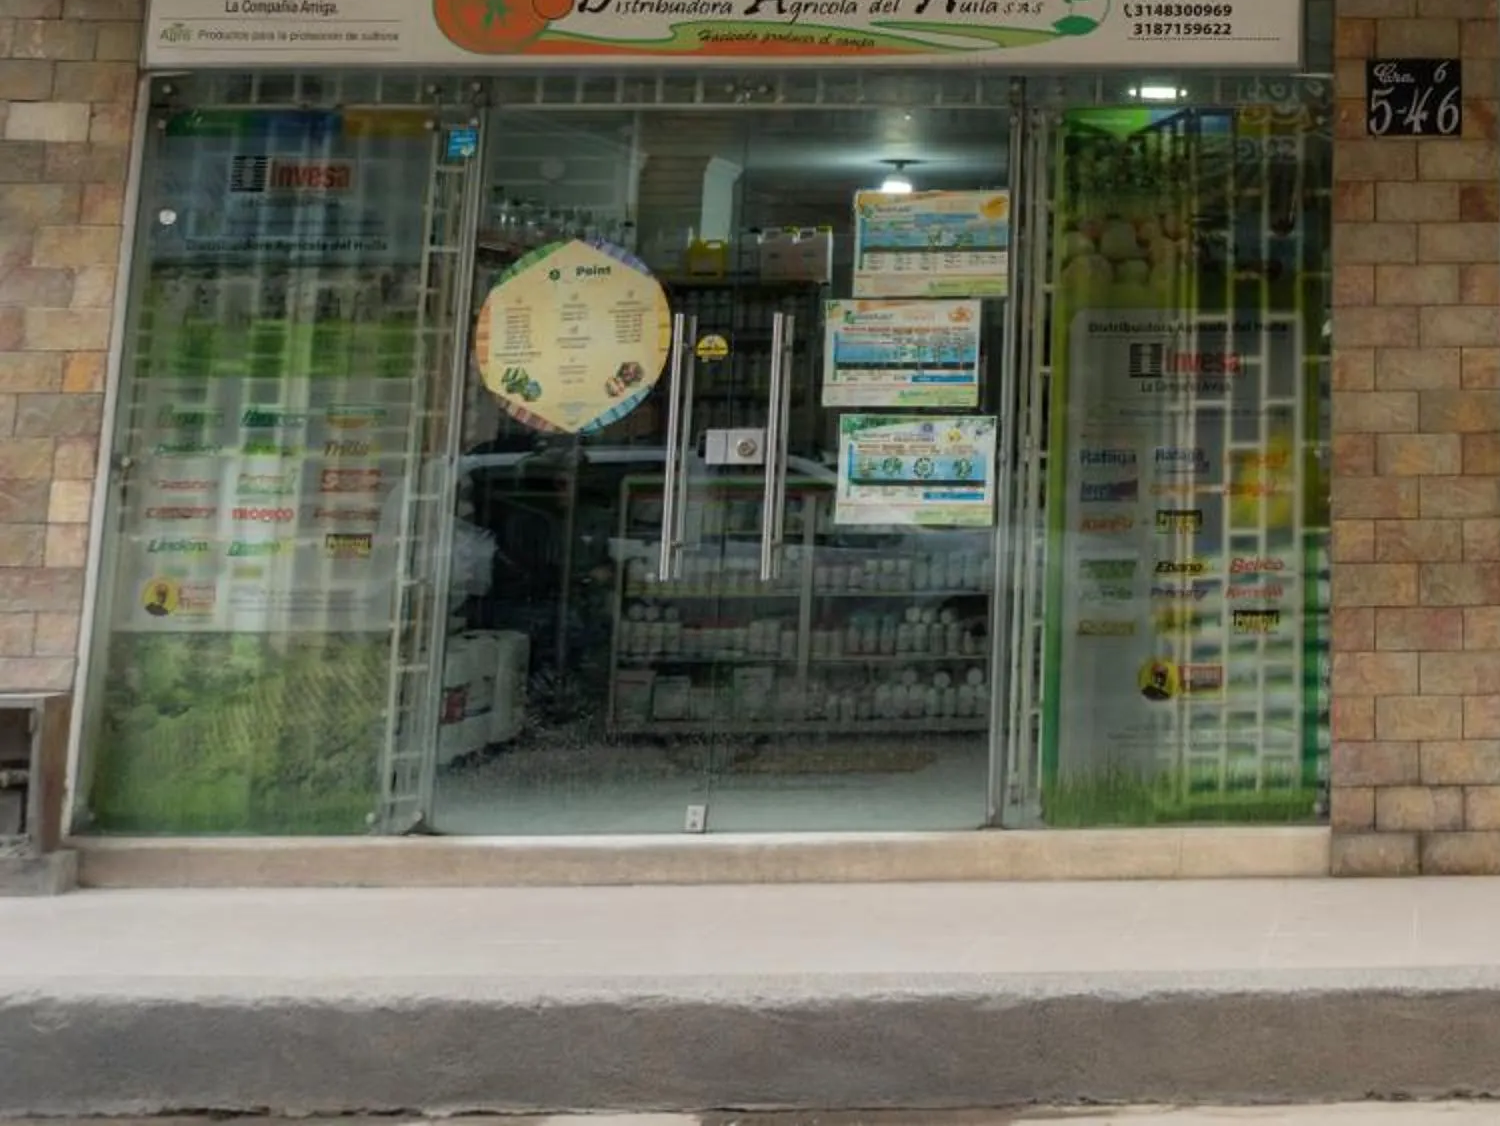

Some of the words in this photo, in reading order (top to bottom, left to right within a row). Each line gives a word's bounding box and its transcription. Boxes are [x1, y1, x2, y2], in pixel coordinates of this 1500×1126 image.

[225, 0, 237, 14] La
[1134, 3, 1232, 17] 3148300969
[1133, 22, 1232, 36] 3187159622
[1433, 61, 1450, 83] 6
[1369, 86, 1460, 135] 5-46
